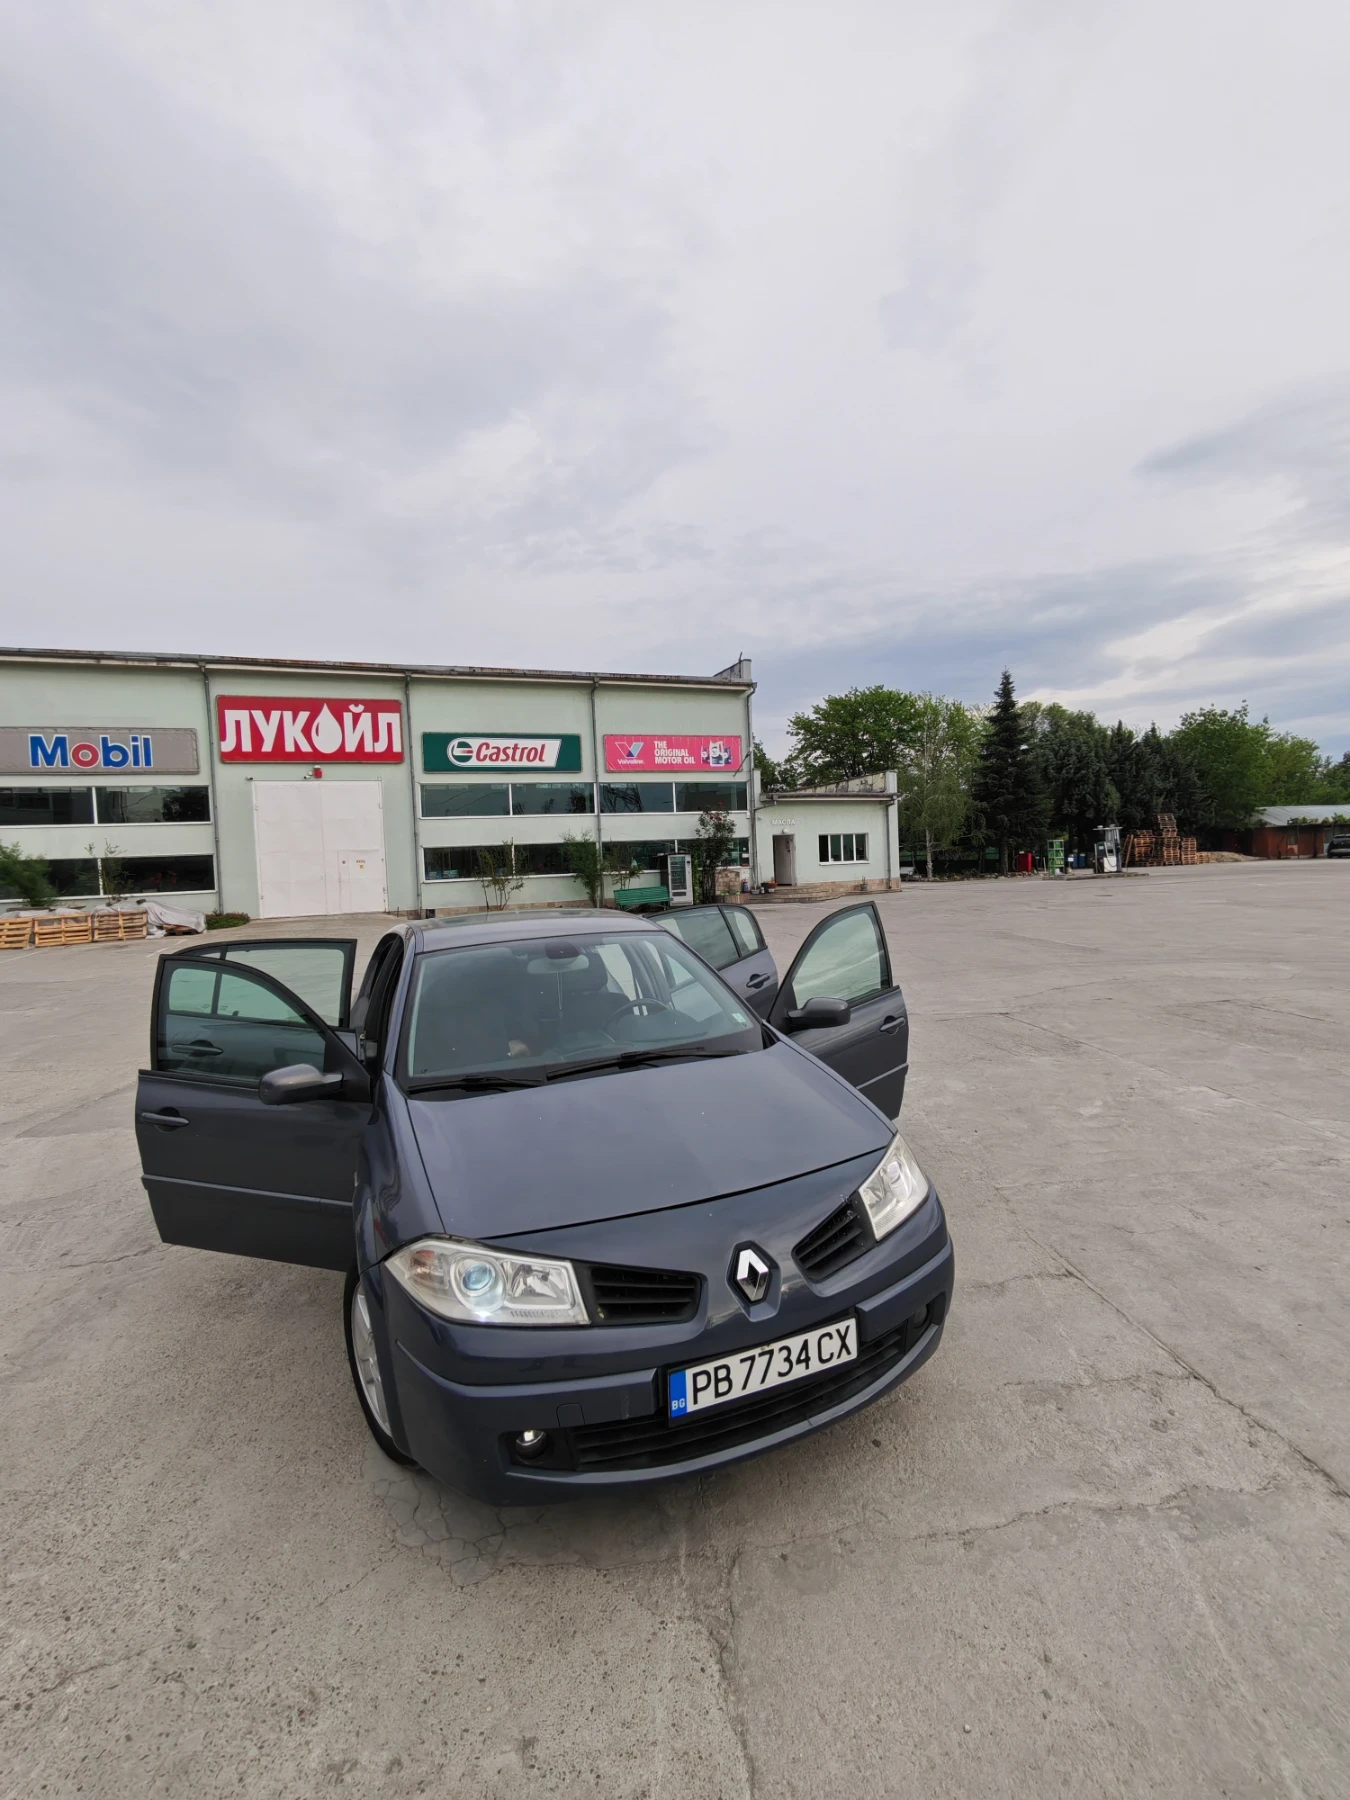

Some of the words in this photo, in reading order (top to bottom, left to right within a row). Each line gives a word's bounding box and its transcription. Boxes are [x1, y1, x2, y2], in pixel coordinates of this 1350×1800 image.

[220, 702, 401, 754] ЛУКОЙЛ
[28, 734, 154, 769] Mobil
[475, 742, 546, 763] Castrol
[654, 741, 667, 749] THE
[671, 1399, 685, 1411] BG
